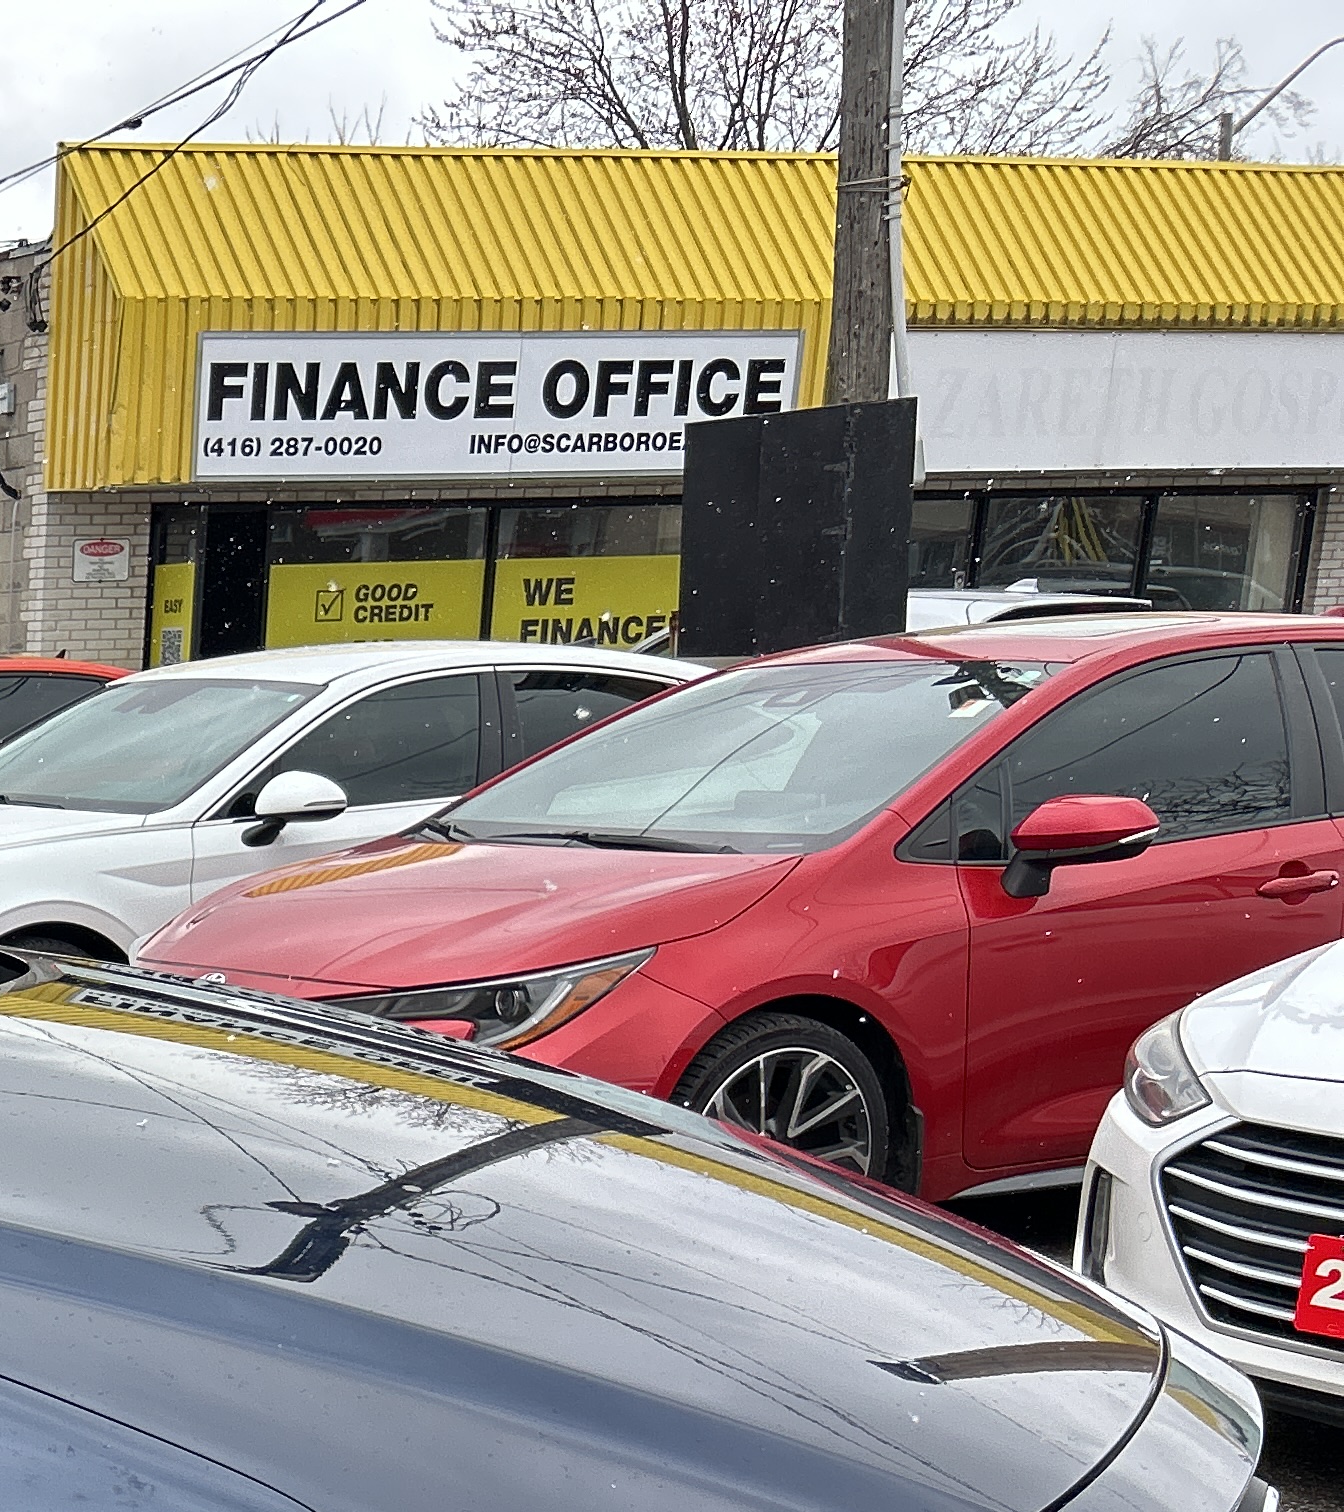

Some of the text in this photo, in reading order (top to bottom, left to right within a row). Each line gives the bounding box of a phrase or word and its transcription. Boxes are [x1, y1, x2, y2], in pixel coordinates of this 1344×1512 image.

[207, 358, 787, 421] FINANCE OFFICE
[1192, 366, 1344, 439] GOSP
[203, 432, 685, 457] (416) 287-0020 INFO@SCARBOROE
[355, 583, 418, 602] GOOD
[523, 577, 576, 606] WE
[164, 599, 184, 614] EASY
[354, 603, 434, 623] CREDIT
